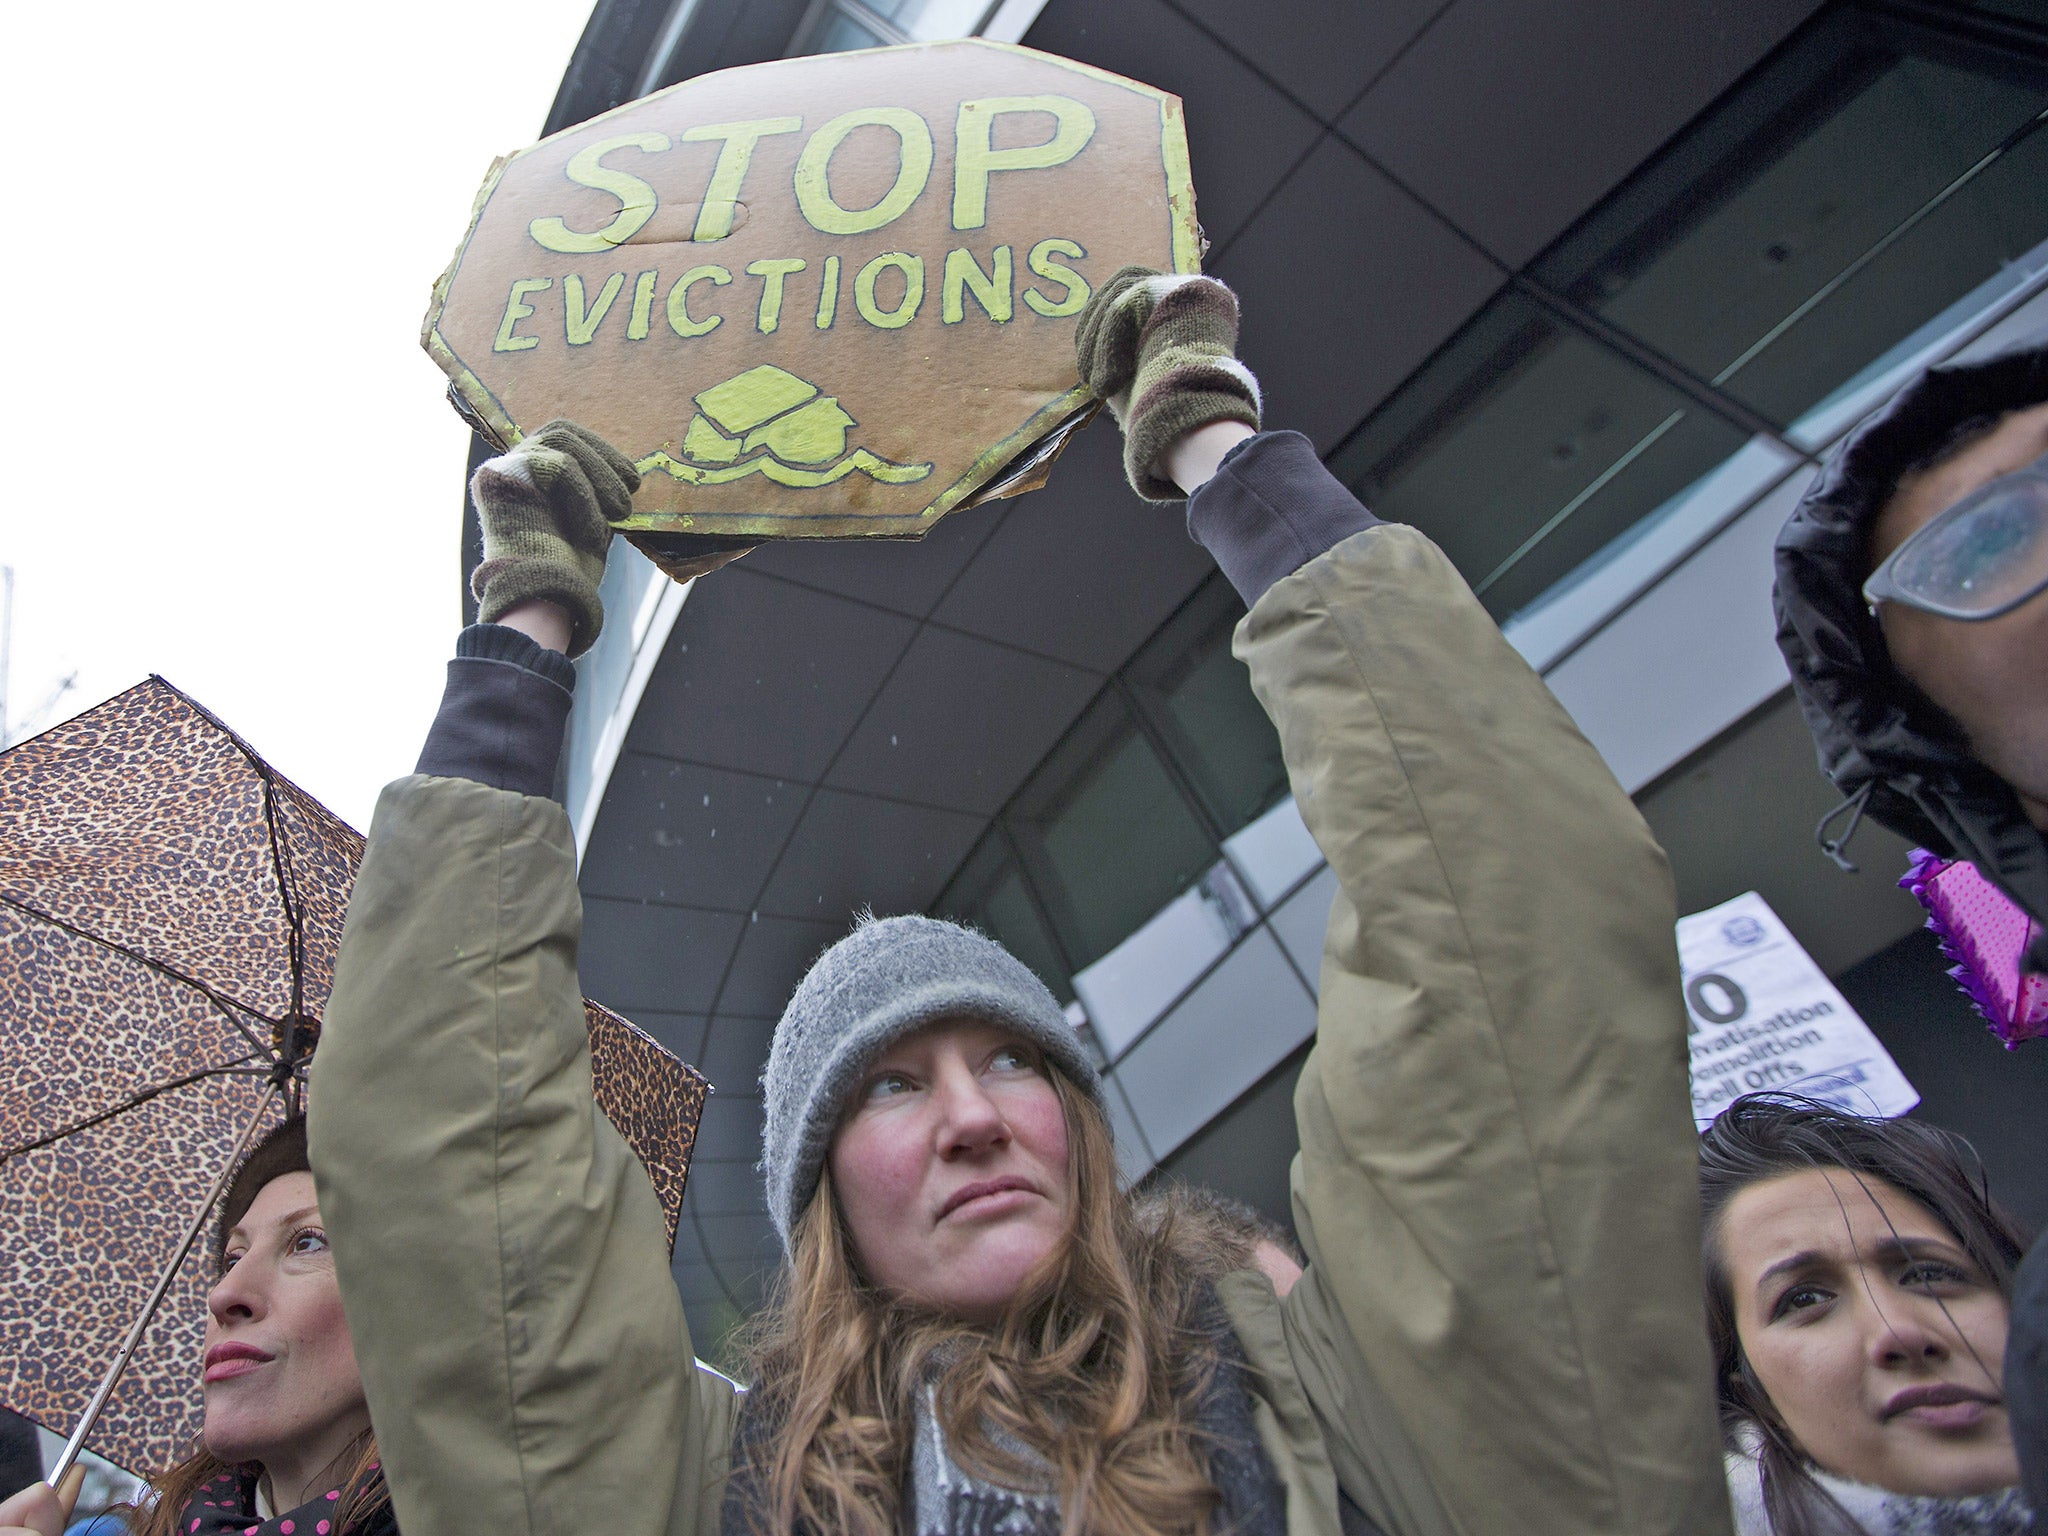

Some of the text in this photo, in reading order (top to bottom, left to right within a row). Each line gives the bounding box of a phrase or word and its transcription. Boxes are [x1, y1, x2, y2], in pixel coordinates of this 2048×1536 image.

[529, 95, 1097, 254] STOP
[493, 238, 1092, 353] EVICTIONS
[1687, 973, 1747, 1034] O
[1691, 1001, 1833, 1057] ivatisation
[1689, 1030, 1823, 1085] emolition
[1692, 1079, 1741, 1108] Sell
[1745, 1061, 1805, 1089] Offs
